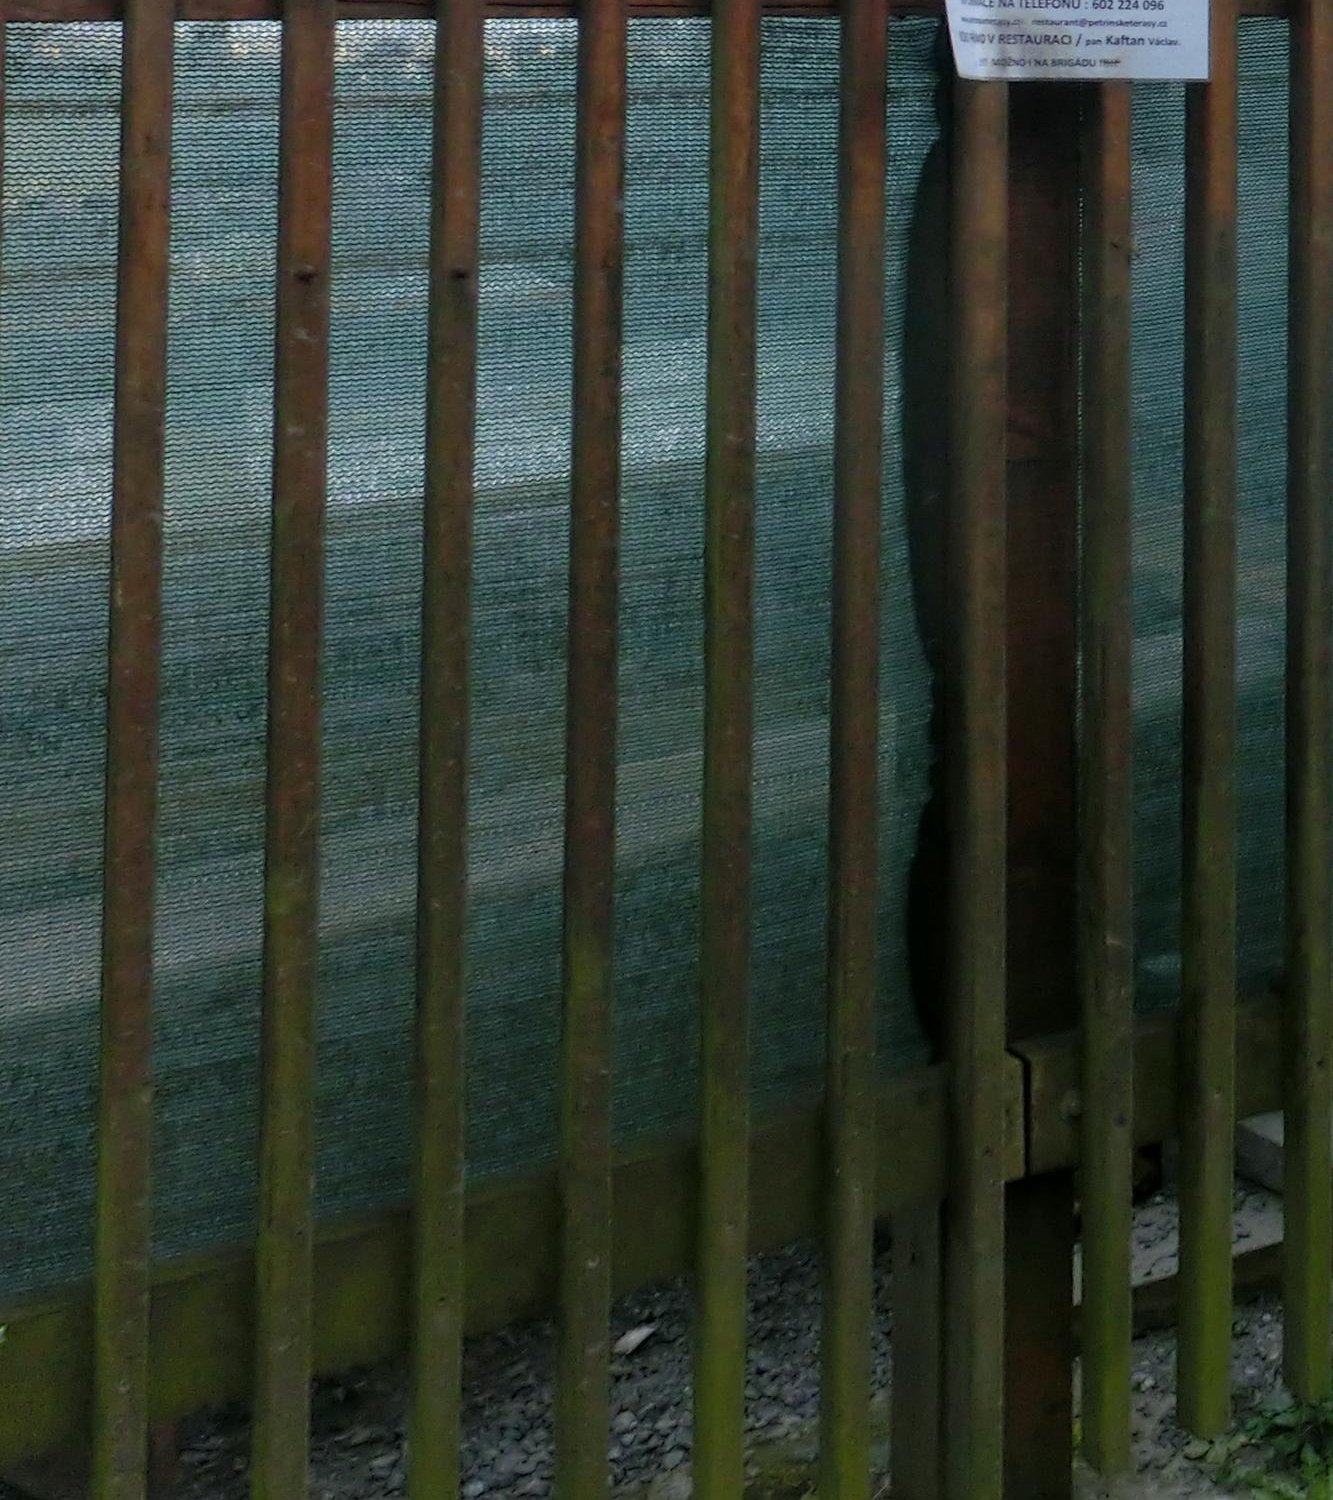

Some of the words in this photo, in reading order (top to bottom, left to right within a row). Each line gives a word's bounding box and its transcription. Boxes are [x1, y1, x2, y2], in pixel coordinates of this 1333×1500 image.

[1091, 0, 1114, 10] 602
[1118, 0, 1140, 11] 224
[1142, 0, 1165, 11] 096
[998, 33, 1072, 45] RESTAURACI
[1105, 35, 1145, 46] Kaftan
[1051, 57, 1096, 68] BRIGÁDU
